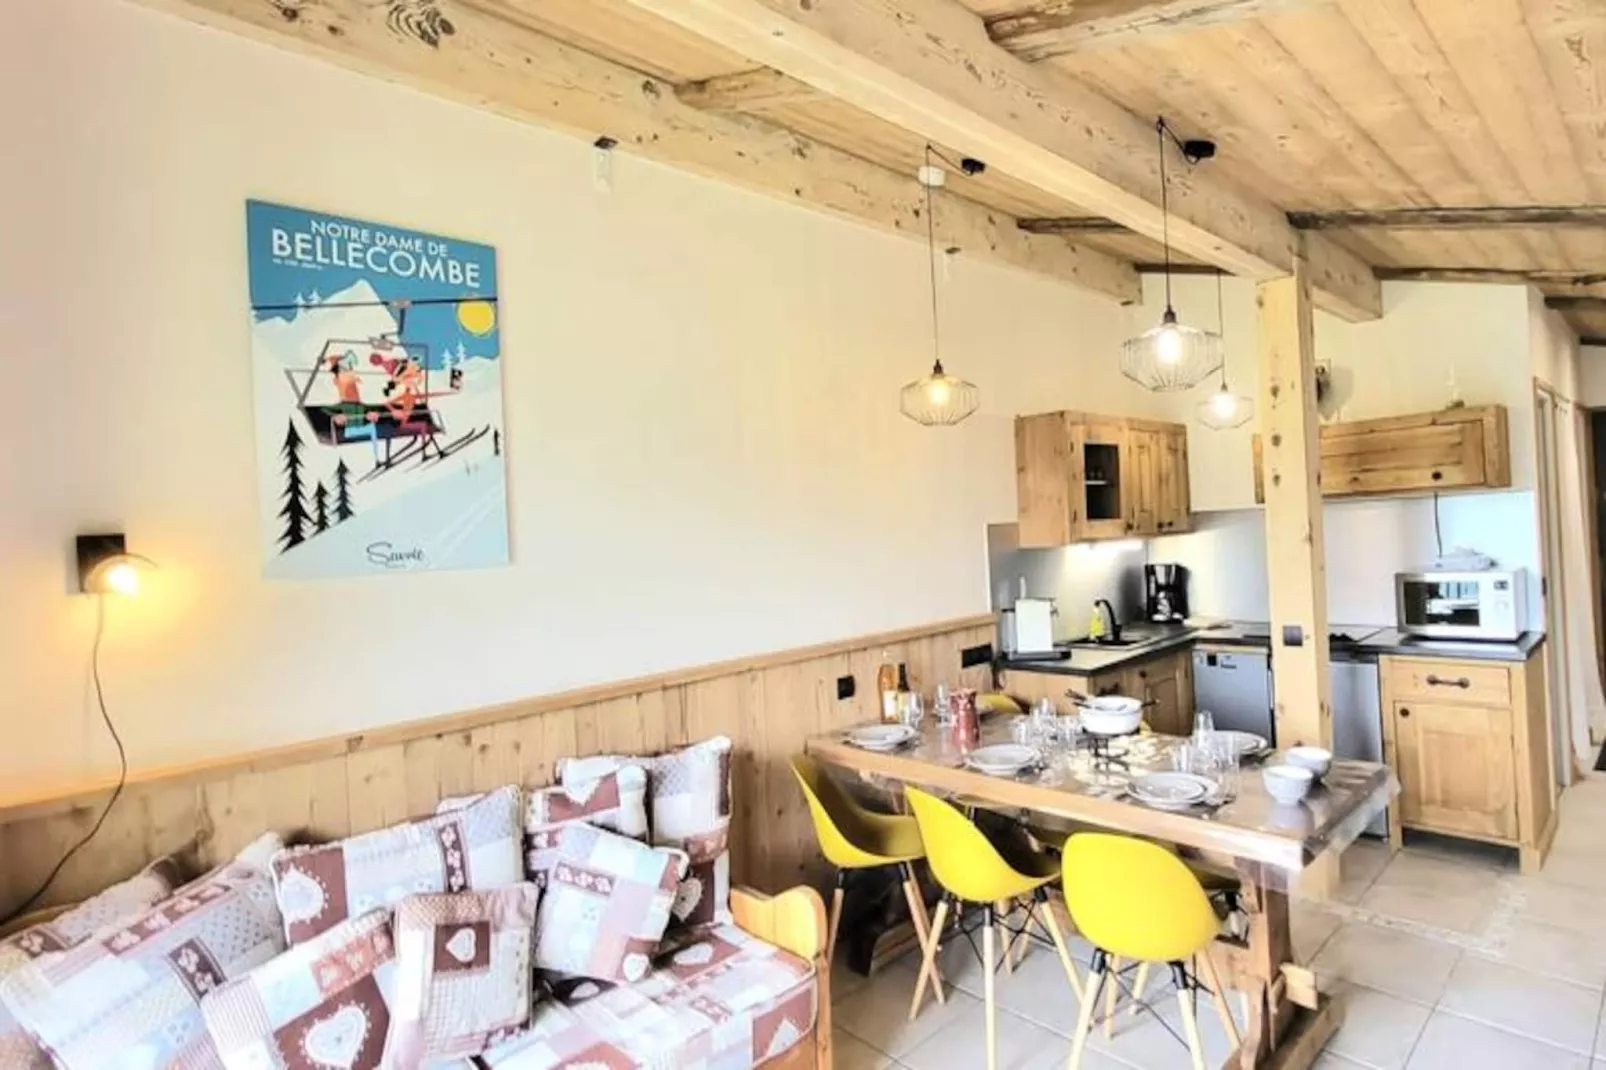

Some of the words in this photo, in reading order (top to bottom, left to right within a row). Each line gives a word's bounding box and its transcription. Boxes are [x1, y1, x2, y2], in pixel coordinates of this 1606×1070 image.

[271, 228, 481, 289] BELLECOMBE
[310, 219, 370, 244] NOTRE
[374, 231, 423, 253] DAME
[427, 242, 449, 258] DE
